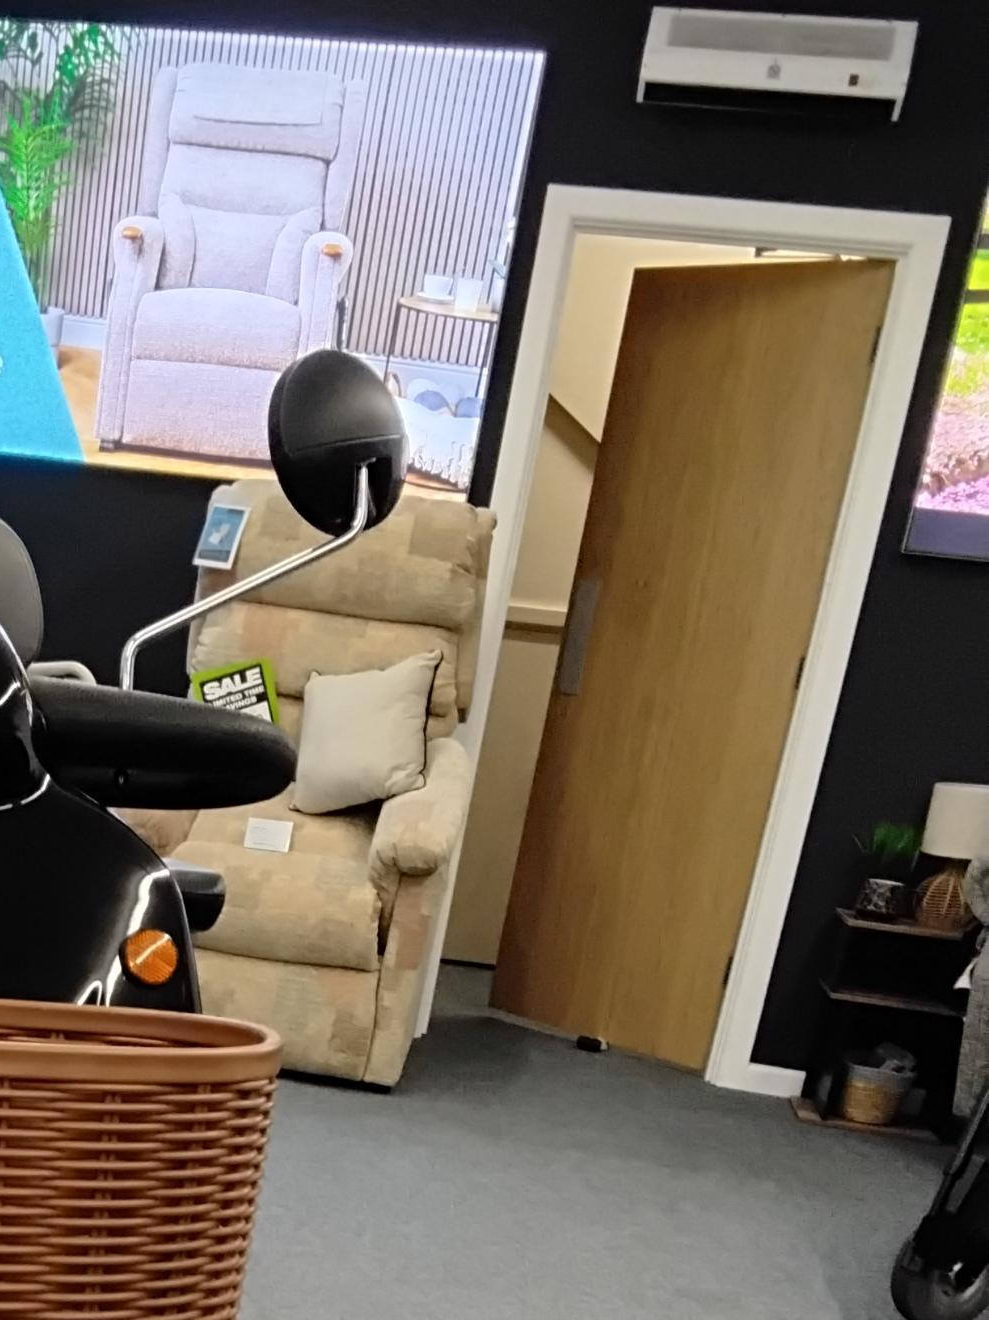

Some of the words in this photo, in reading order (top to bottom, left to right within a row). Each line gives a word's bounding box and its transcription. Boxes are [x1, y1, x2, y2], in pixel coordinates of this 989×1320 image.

[203, 666, 264, 701] SALE
[210, 692, 243, 708] IMITED
[224, 695, 258, 711] AVINGS
